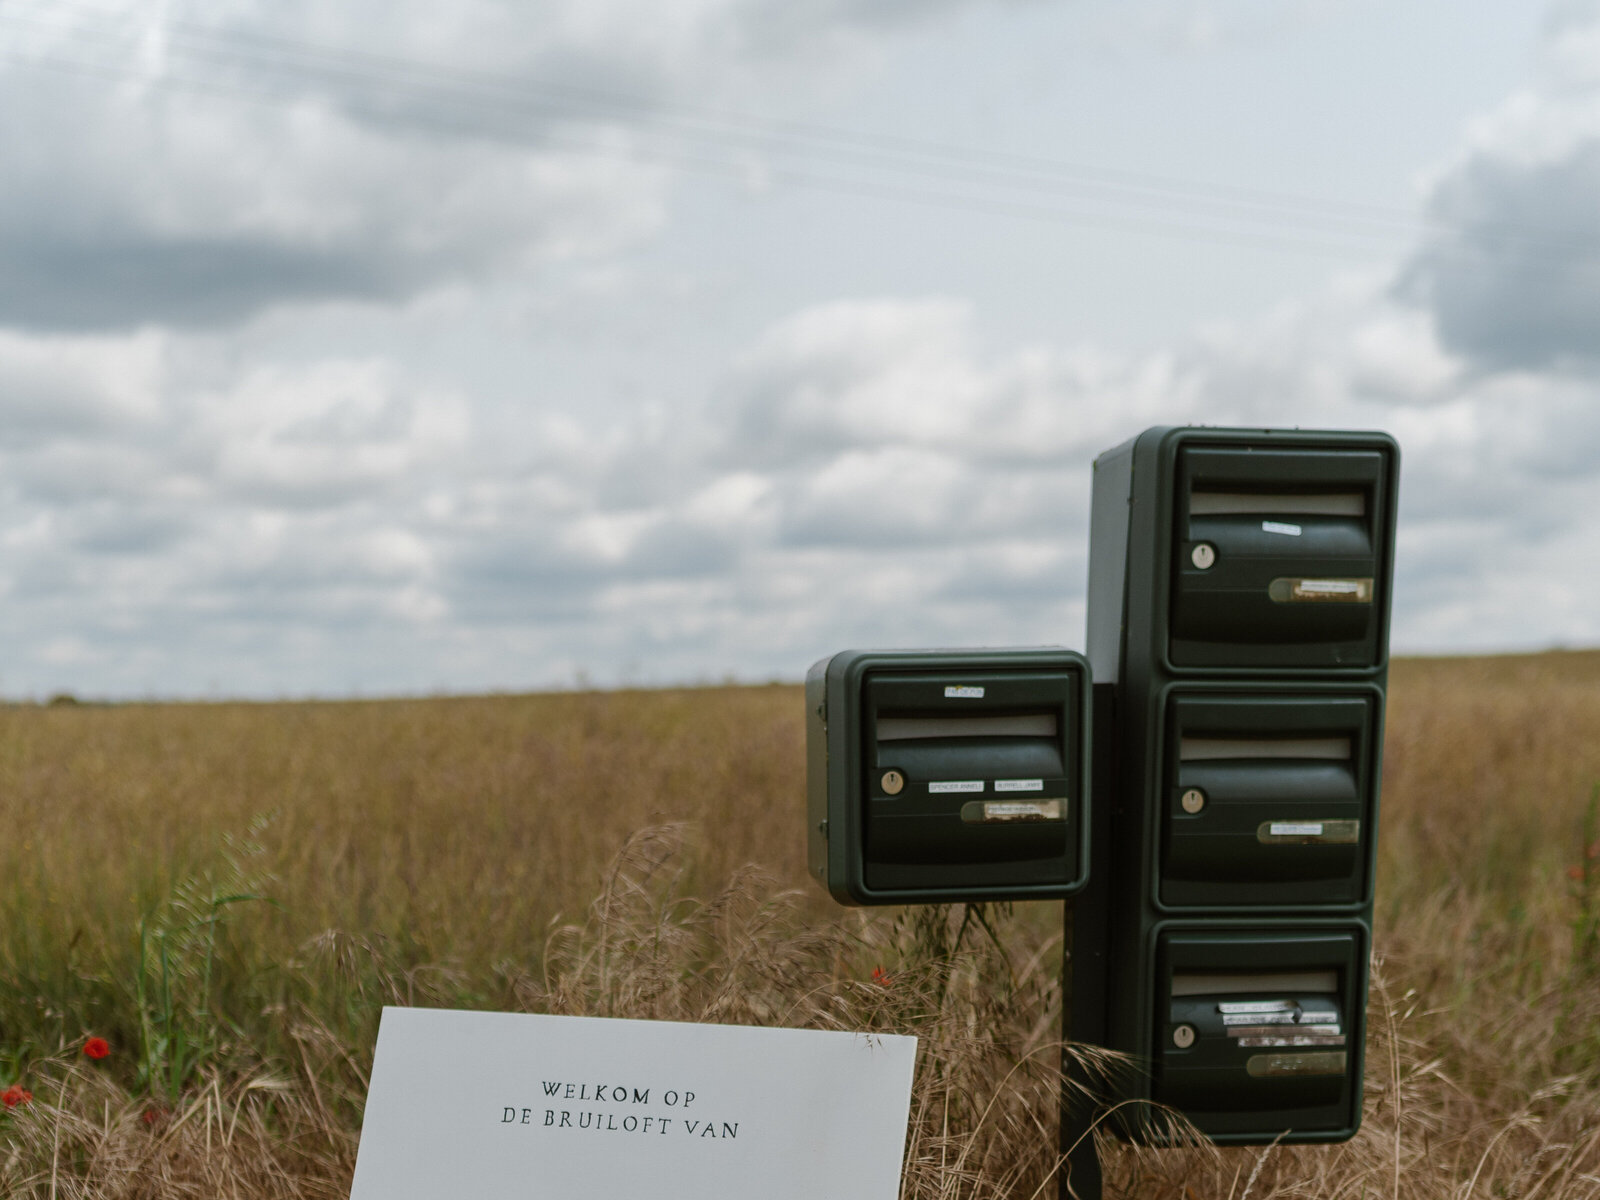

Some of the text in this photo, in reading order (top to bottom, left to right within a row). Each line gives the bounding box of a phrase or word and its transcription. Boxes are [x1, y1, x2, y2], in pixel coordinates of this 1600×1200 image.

[542, 1081, 696, 1108] WELKOM OP
[501, 1107, 739, 1139] DE BRUILOFT VAN
